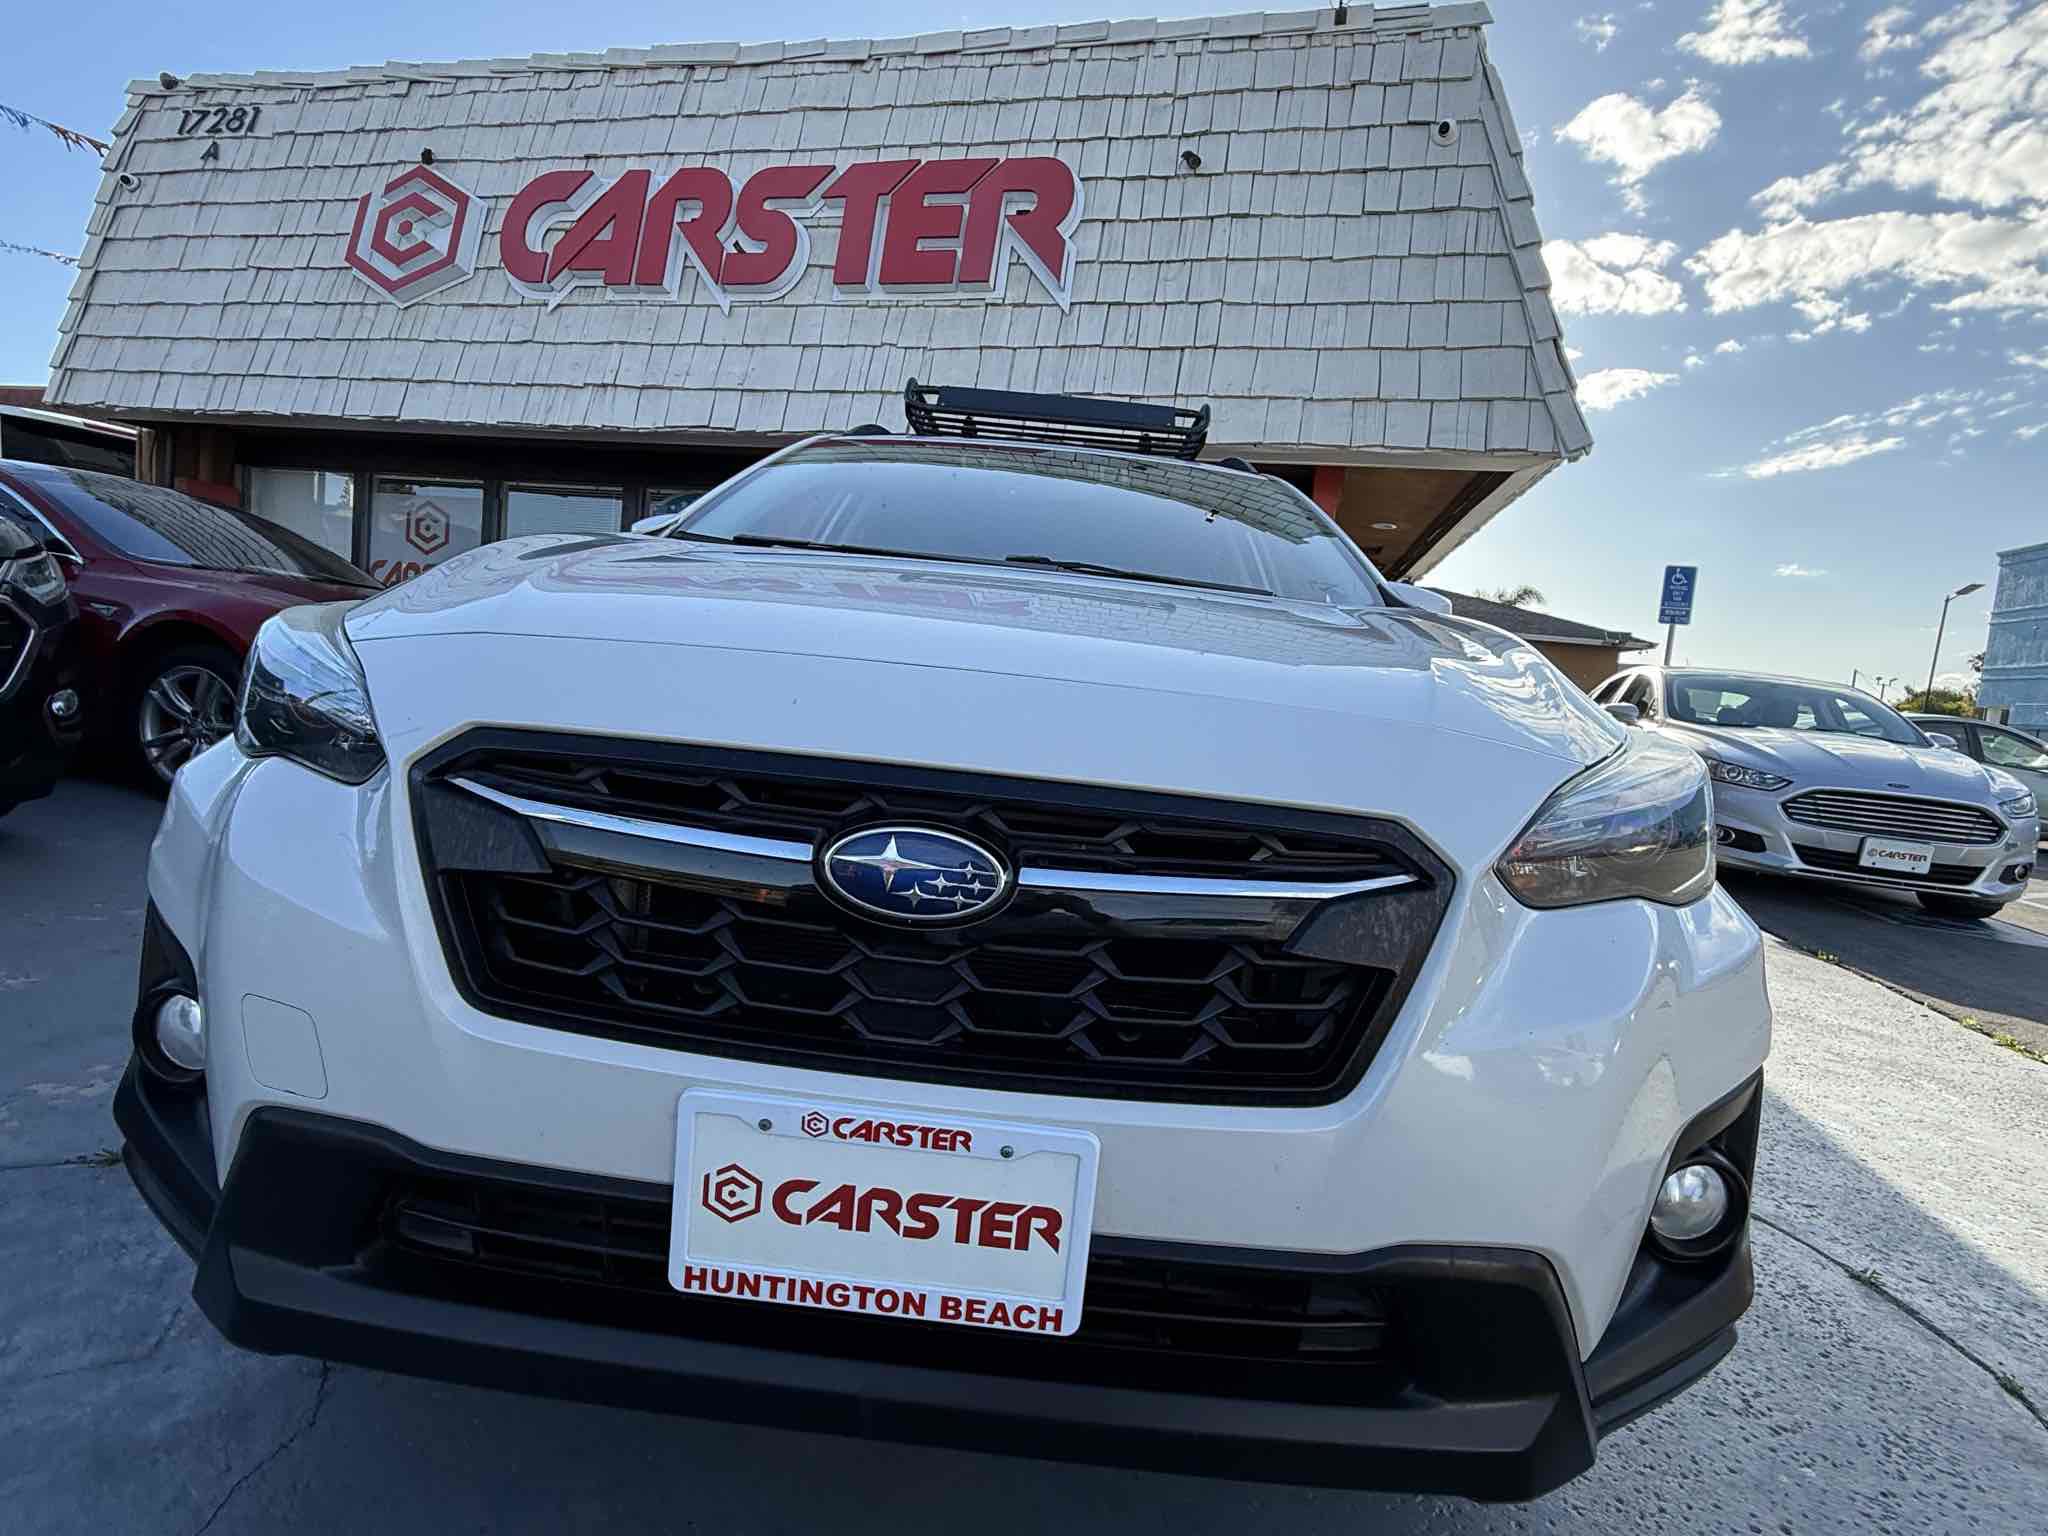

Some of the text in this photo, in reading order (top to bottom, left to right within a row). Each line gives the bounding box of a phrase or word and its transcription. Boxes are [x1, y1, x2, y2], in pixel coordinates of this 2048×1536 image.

[177, 106, 261, 135] 17281
[200, 140, 219, 161] A
[500, 156, 1077, 290] CARSTER
[832, 1117, 972, 1152] CARSTER
[772, 1179, 1063, 1255] CARSTER
[683, 1266, 1063, 1332] HUNTINGTON BEACH
